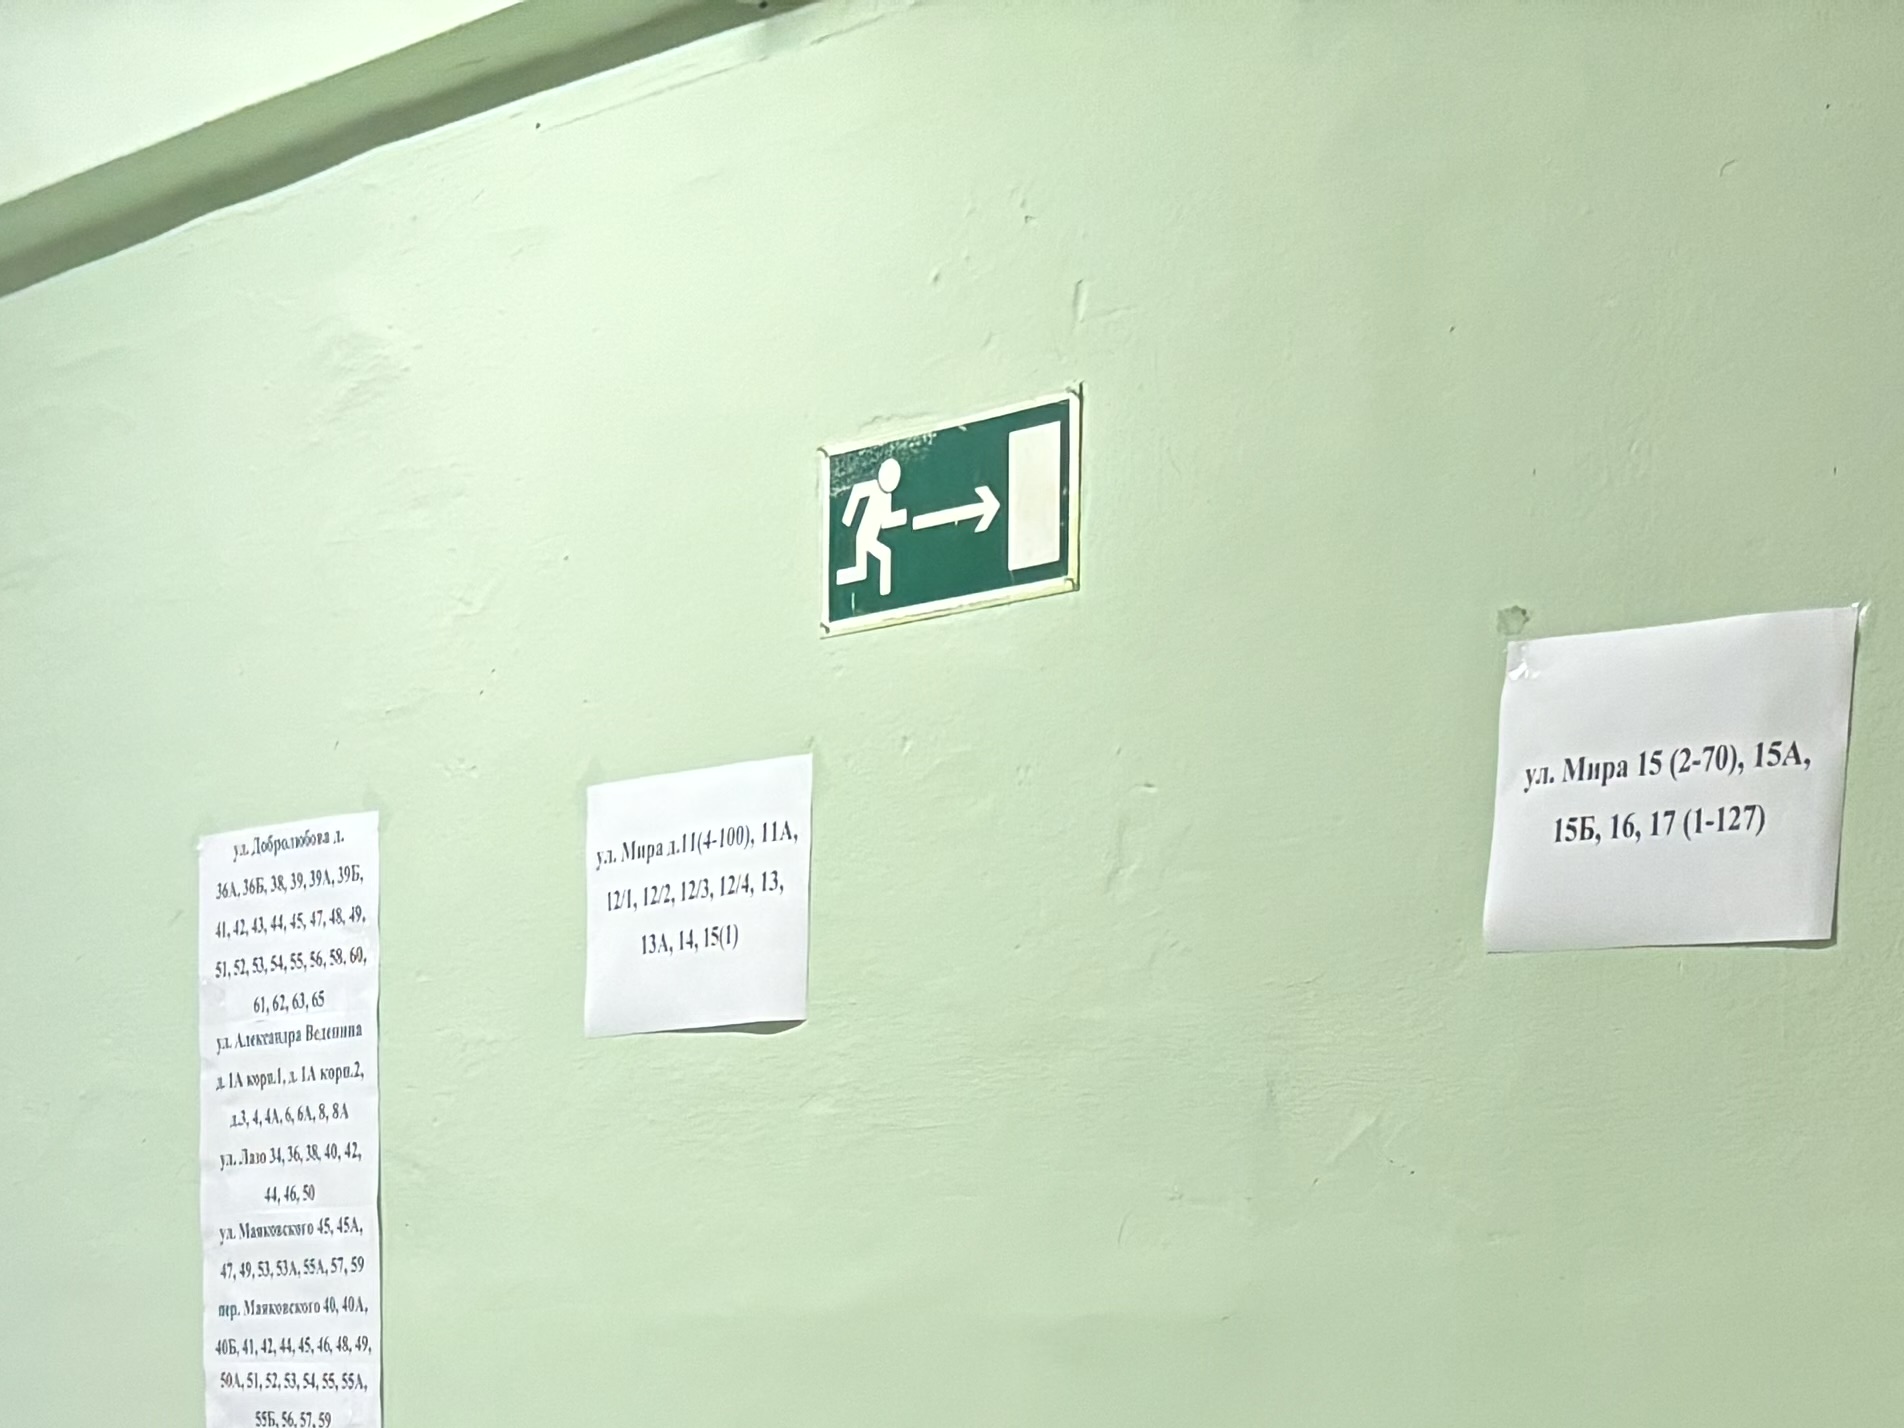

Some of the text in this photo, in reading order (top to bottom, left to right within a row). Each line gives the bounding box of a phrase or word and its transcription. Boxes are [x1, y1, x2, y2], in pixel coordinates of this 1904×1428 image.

[1523, 740, 1811, 793] ул. Мира 15 (2-70), 15А,
[1554, 804, 1766, 846] 15Б, 16, 17 (1-127)
[596, 849, 617, 871] ул.
[621, 839, 663, 864] Мира
[762, 820, 799, 844] 11А,
[216, 882, 241, 899] 36А,
[243, 877, 267, 895] 36Б,
[290, 872, 306, 890] 39,
[309, 868, 335, 888] 39А,
[337, 864, 363, 884] 39Б,
[607, 870, 784, 911] 12/1, 12/2, 12/3, 12/4, 13,
[216, 905, 366, 939] 41, 42, 43, 44, 45, 47, 48, 49,
[641, 923, 739, 956] 13А, 14, 15(1)
[215, 961, 231, 980] 51,
[234, 958, 249, 976] 52,
[252, 956, 267, 974] 53,
[271, 955, 287, 973] 54,
[290, 952, 307, 972] 55,
[310, 950, 326, 969] 56,
[350, 946, 367, 965] 60,
[254, 990, 324, 1015] 61, 62, 63, 65
[235, 1031, 301, 1048] Александра
[253, 1109, 262, 1127] 4,
[265, 1108, 283, 1125] 4А,
[297, 1105, 316, 1122] 6А,
[319, 1103, 328, 1123] 8,
[332, 1102, 349, 1119] 8А
[220, 1153, 237, 1171] ул.
[287, 1146, 303, 1164] 36,
[324, 1143, 341, 1161] 40,
[345, 1142, 361, 1162] 42,
[264, 1184, 315, 1204] 44, 46, 50
[220, 1216, 363, 1245] ул. Маяковского 45, 45А,
[221, 1256, 364, 1281] 47, 49, 53, 53А, 55А, 57, 59
[244, 1299, 320, 1316] Маяковского
[323, 1296, 339, 1315] 40,
[342, 1296, 368, 1314] 40А,
[215, 1336, 371, 1356] 40Б, 41, 42, 44, 45, 46, 48, 49,
[221, 1372, 368, 1392] 50А, 51, 52, 53, 54, 55, 55А,
[255, 1411, 331, 1428] 55Б, 56, 57, 59
